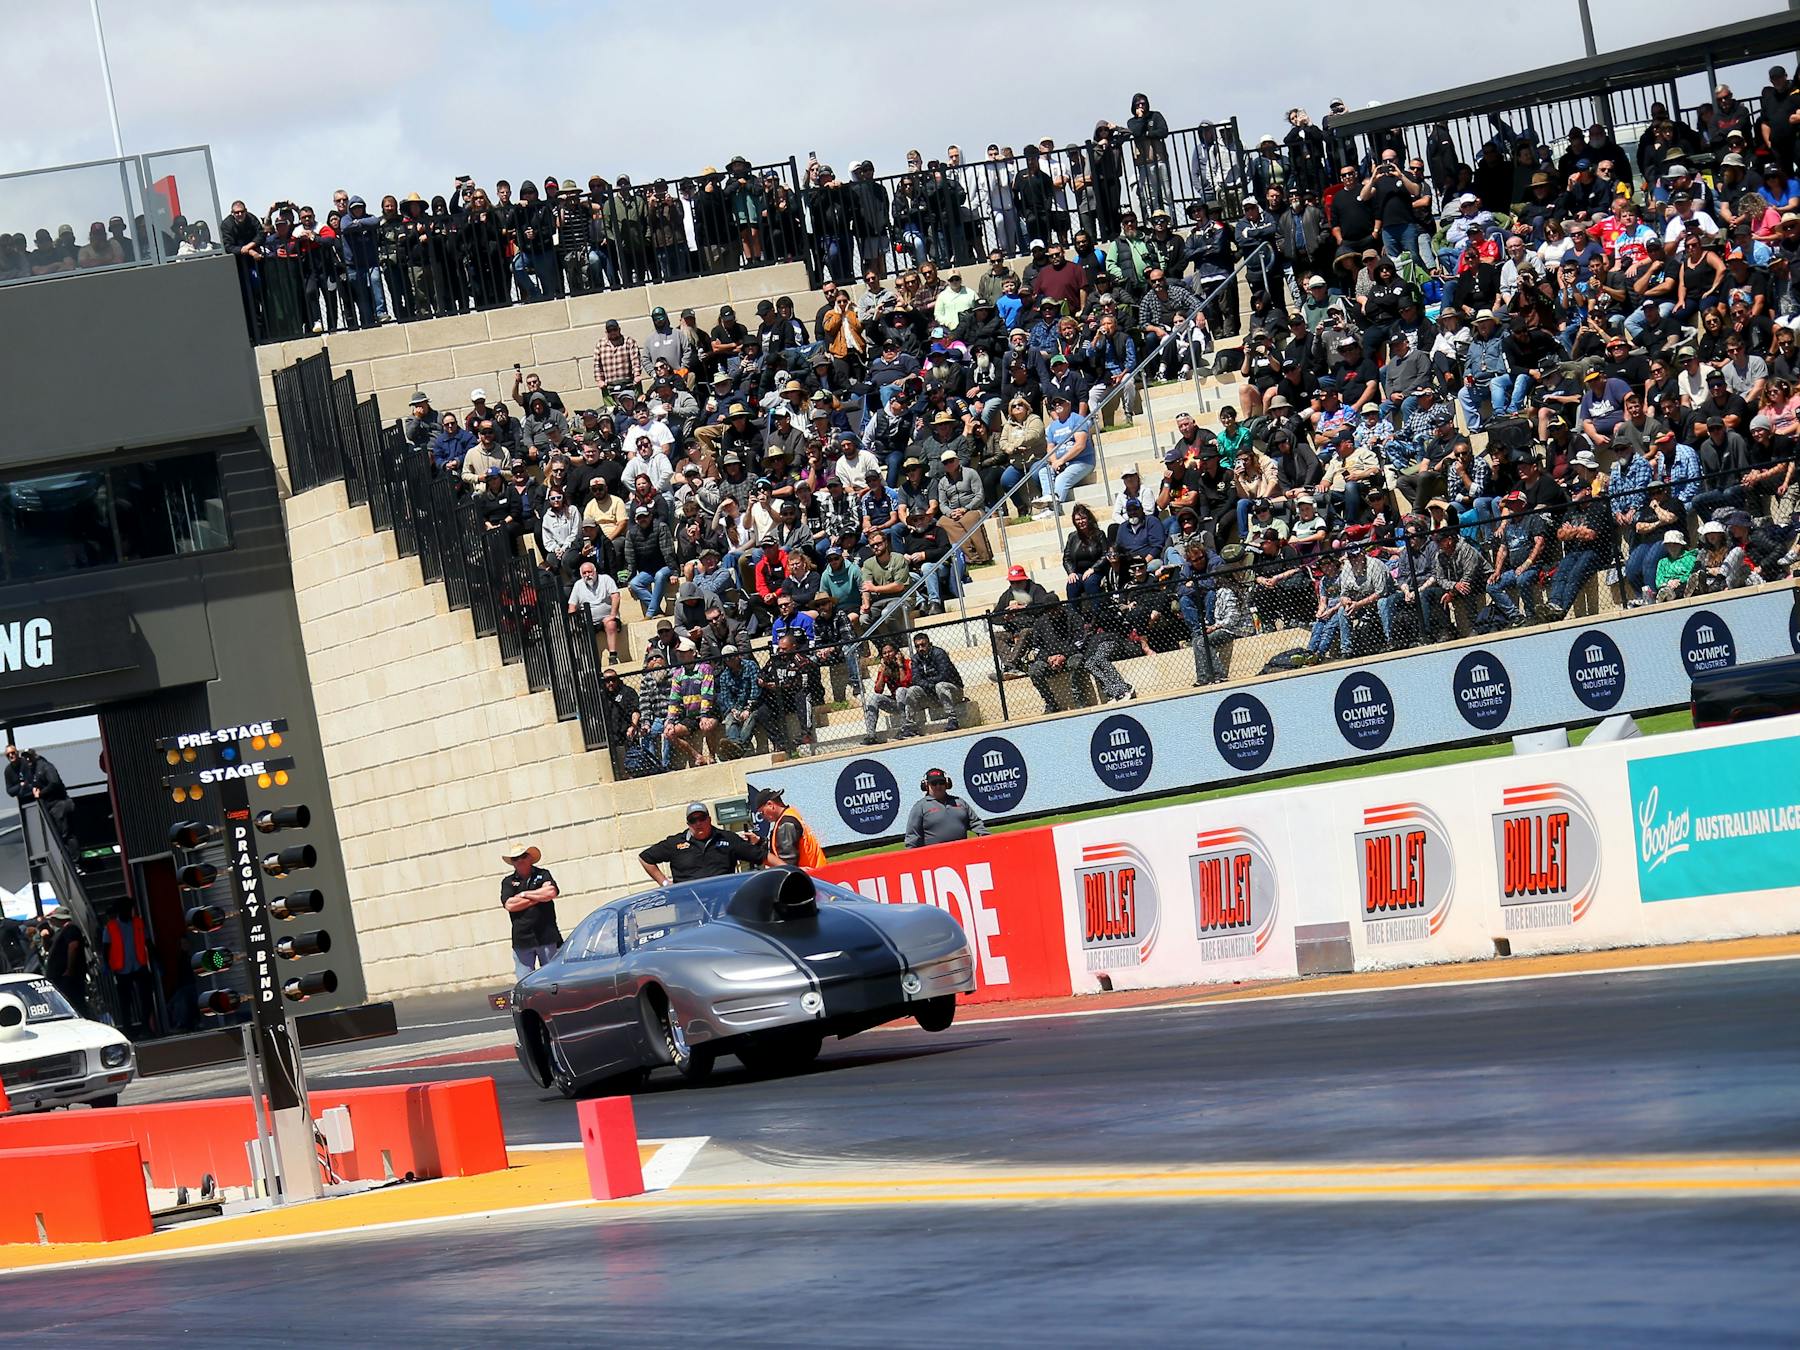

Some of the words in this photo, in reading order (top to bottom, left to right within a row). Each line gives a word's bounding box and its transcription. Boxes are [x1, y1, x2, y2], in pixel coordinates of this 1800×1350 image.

[1688, 644, 1730, 662] OLYMPIC
[1576, 663, 1620, 682] OLYMPIC
[1695, 659, 1727, 670] INDUSTRIES
[1461, 683, 1506, 701] OLYMPIC
[1582, 677, 1617, 689] INDUSTRIES
[1342, 703, 1388, 722] OLYMPIC
[1467, 697, 1503, 709] INDUSTRIES
[1349, 716, 1385, 729] INDUSTRIES
[178, 721, 274, 749] PRE-STAGE
[1221, 724, 1268, 743] OLYMPIC
[1228, 738, 1265, 750] INDUSTRIES
[1098, 745, 1146, 764] OLYMPIC
[200, 762, 266, 783] STAGE
[1105, 758, 1143, 771] INDUSTRIES
[972, 766, 1021, 786] OLYMPIC
[978, 780, 1018, 793] INDUSTRIES
[843, 789, 893, 807] OLYMPIC
[850, 803, 889, 815] INDUSTRIES
[1639, 785, 1690, 863] Coopers
[1695, 809, 1771, 841] AUSTRALIAN
[1504, 813, 1569, 898] BULLET
[235, 827, 257, 918] DRAGWAY
[1365, 831, 1426, 913] BULLET
[1198, 854, 1252, 932] BULLET
[1084, 868, 1136, 942] BULLET
[1505, 908, 1523, 930] RACE
[1524, 903, 1571, 928] ENGINEERING
[250, 933, 265, 942] THE
[251, 925, 262, 934] AT
[1366, 922, 1384, 944] RACE
[1385, 917, 1428, 942] ENGINEERING
[1201, 940, 1216, 961] RACE
[1217, 935, 1255, 959] ENGINEERING
[1086, 950, 1102, 971] RACE
[1102, 946, 1140, 969] ENGINEERING
[256, 950, 273, 1002] BEND
